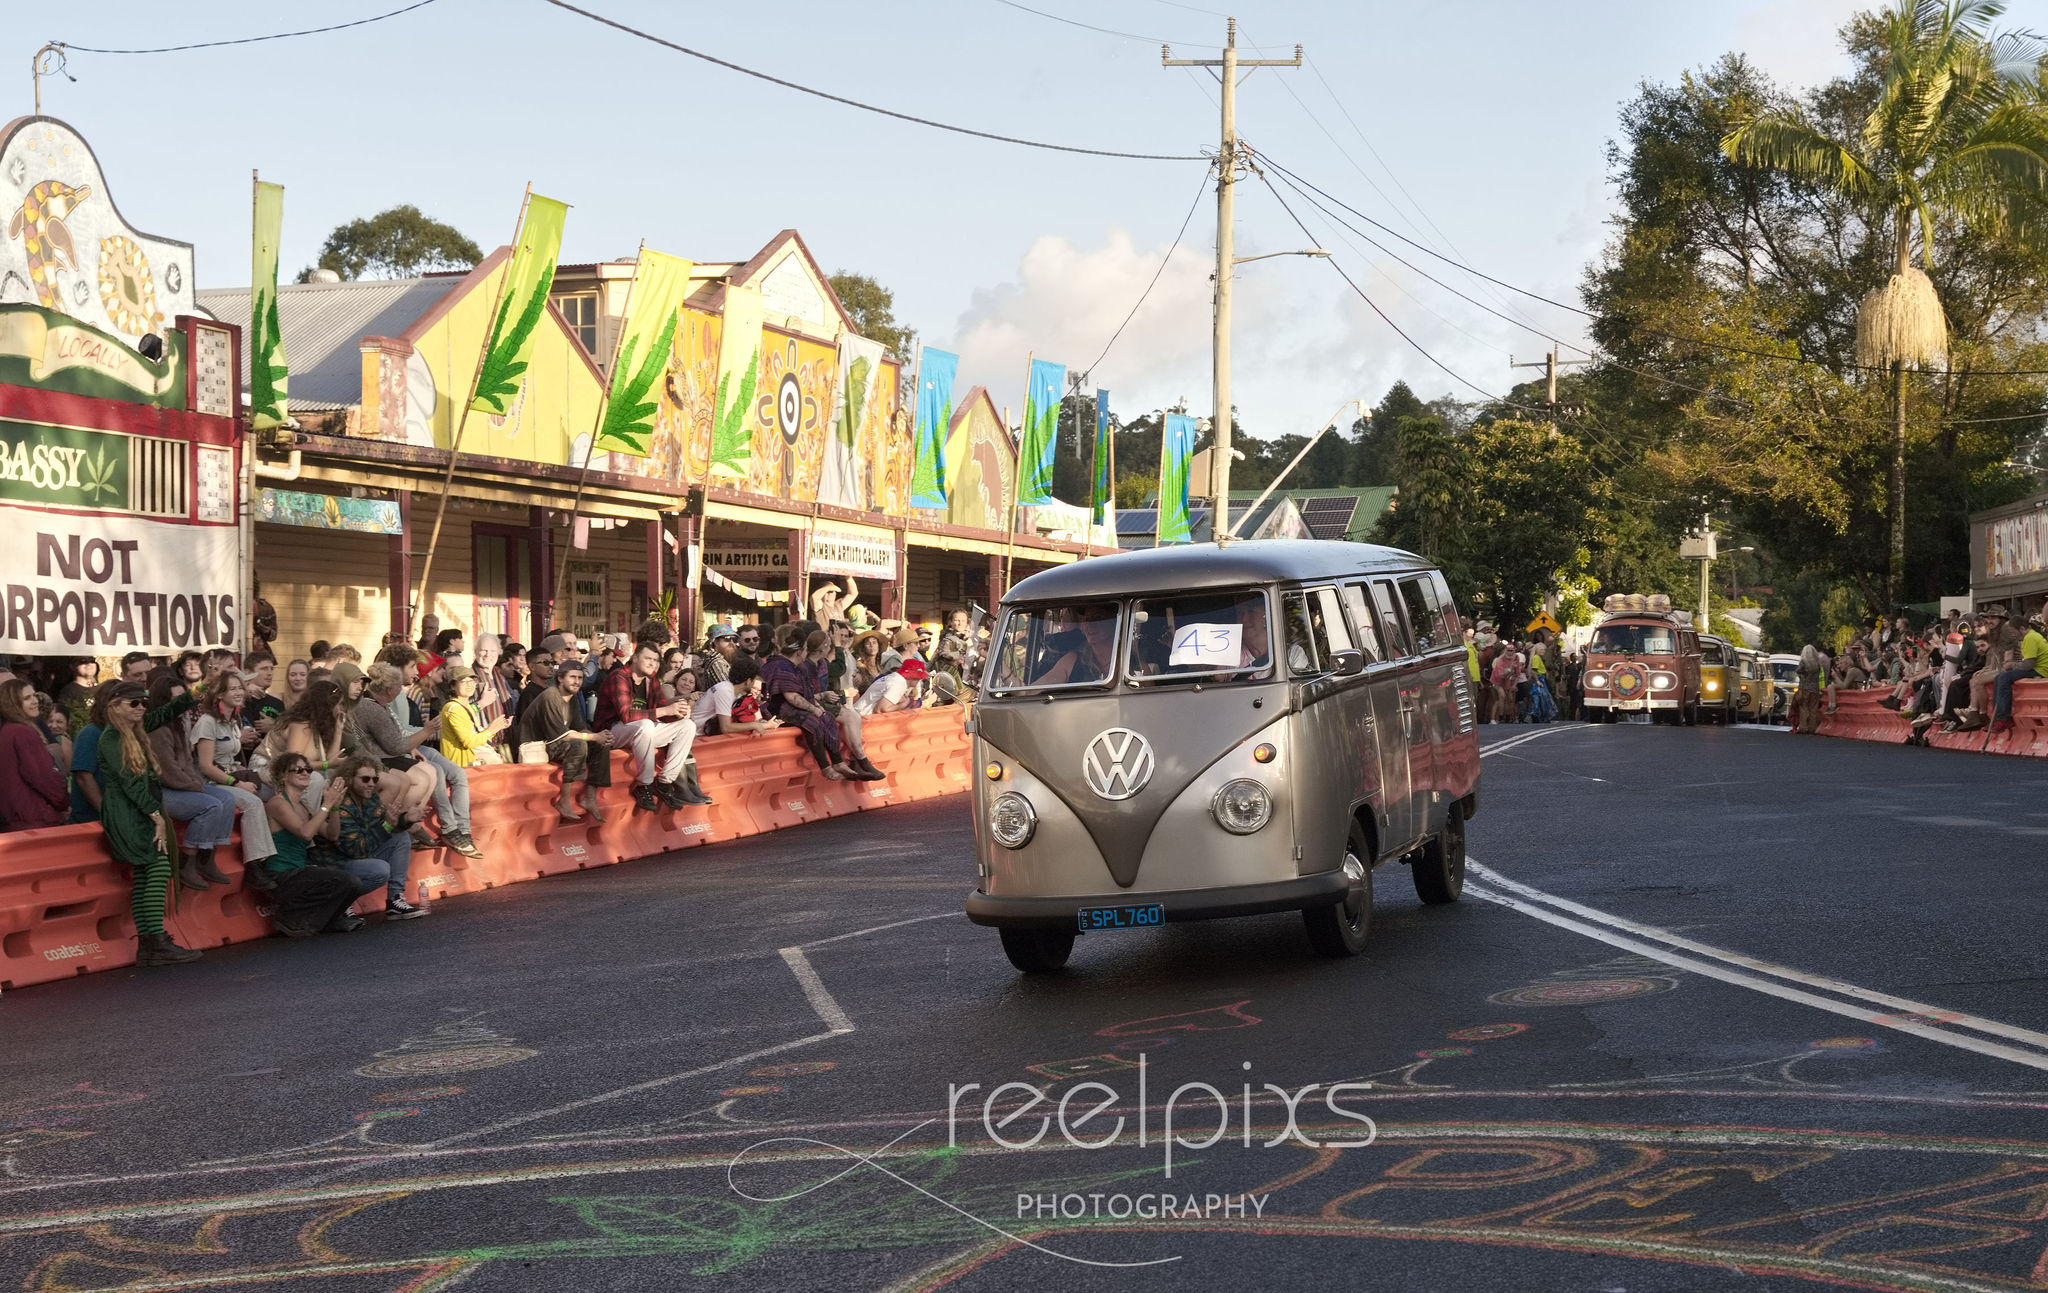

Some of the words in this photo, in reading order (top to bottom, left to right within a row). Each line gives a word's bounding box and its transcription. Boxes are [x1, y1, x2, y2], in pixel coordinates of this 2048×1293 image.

[58, 335, 129, 371] LOCALLY
[37, 532, 139, 585] NOT
[726, 554, 768, 566] ARTISTS
[837, 544, 862, 563] ARTISTS
[863, 547, 890, 566] GALLERY
[576, 580, 601, 595] NIMBIN
[0, 584, 234, 648] RPORATIONS
[577, 602, 601, 616] ARTISTS
[1177, 629, 1230, 656] 43
[1083, 727, 1154, 800] VW
[1091, 907, 1160, 927] SPL760
